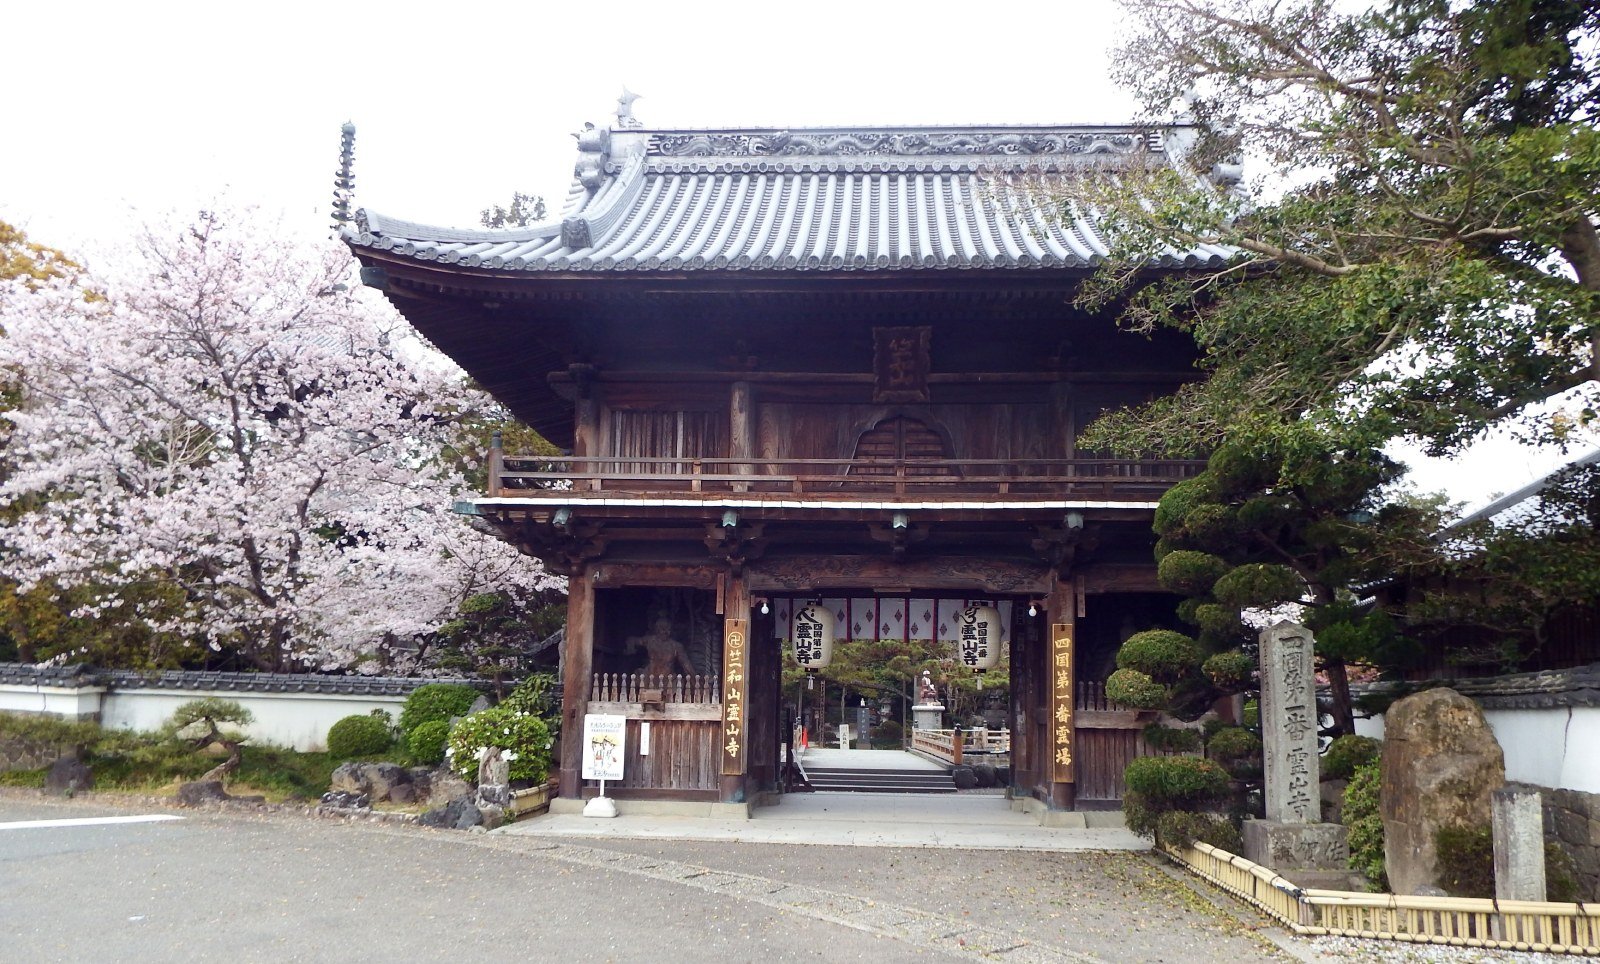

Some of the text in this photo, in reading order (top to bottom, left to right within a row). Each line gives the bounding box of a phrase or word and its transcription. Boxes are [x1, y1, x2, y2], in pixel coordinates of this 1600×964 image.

[1054, 637, 1072, 766] 四国第一番霊場
